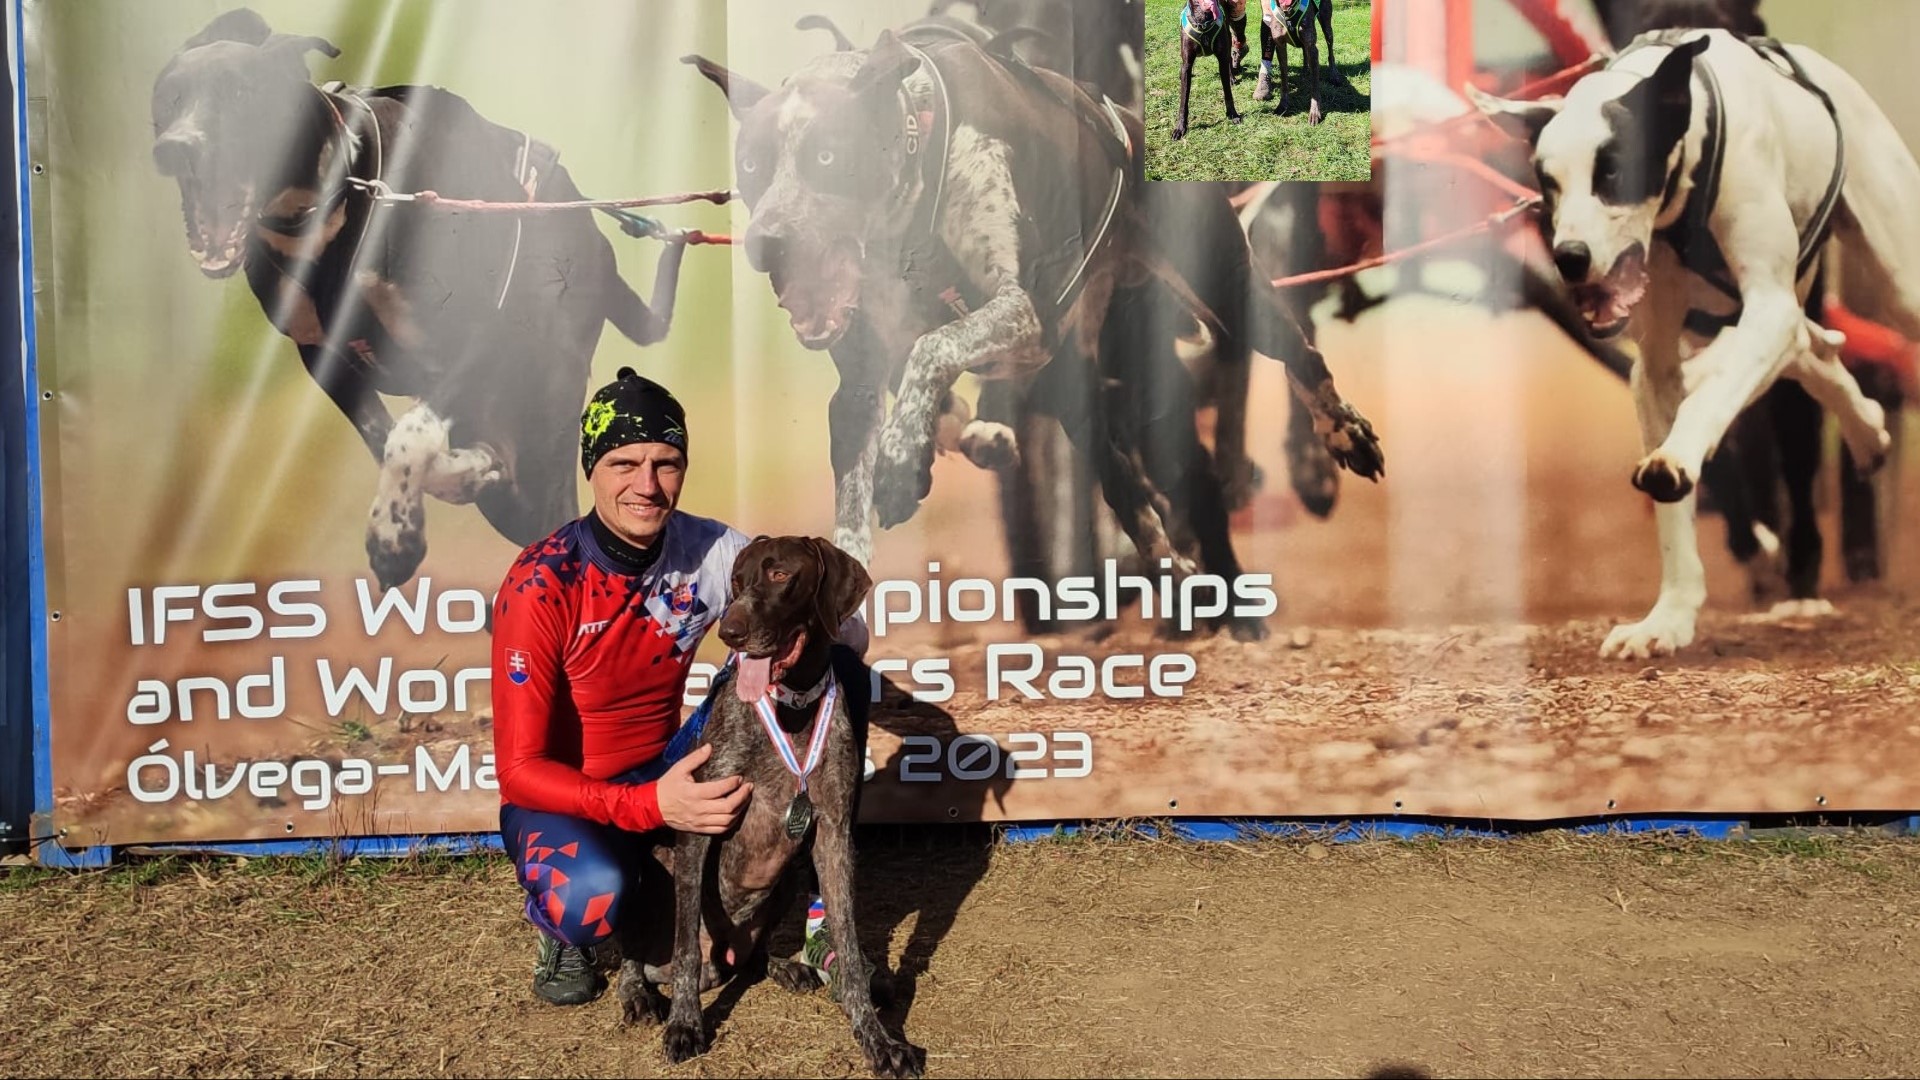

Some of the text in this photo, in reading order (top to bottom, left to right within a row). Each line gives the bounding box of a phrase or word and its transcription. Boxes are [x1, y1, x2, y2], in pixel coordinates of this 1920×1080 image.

[127, 557, 1278, 645] IFSS Wo pionships
[126, 655, 286, 725] and
[316, 656, 493, 717] Wor
[986, 642, 1198, 701] Race
[126, 737, 500, 811] Ólvega-Ma
[899, 730, 1094, 784] 2023
